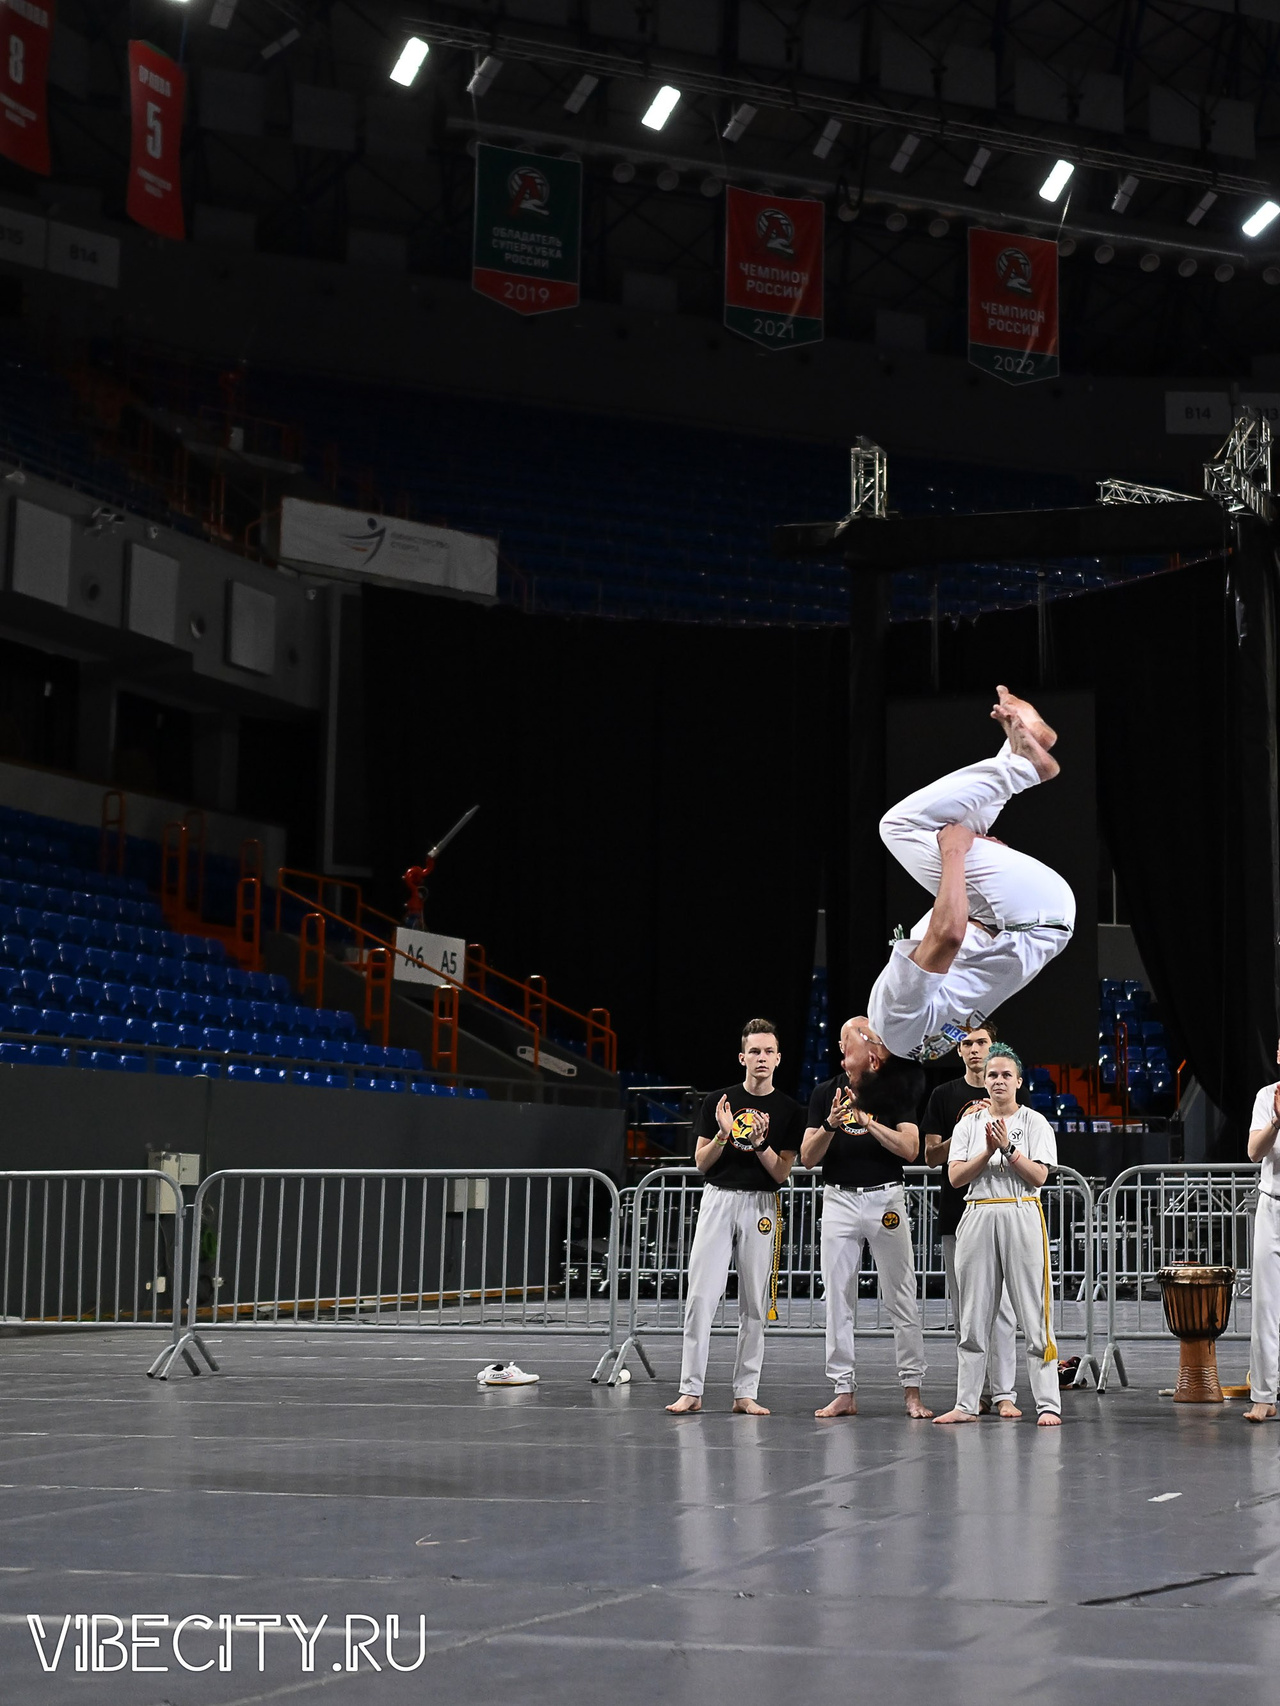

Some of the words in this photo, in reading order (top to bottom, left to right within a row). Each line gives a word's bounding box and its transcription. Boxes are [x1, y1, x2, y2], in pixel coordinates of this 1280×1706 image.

[9, 34, 24, 85] 8
[146, 101, 162, 159] 5
[492, 226, 563, 248] ОБЛАДАТЕЛЬ
[492, 238, 563, 259] СУПЕРКУБКА
[504, 252, 550, 269] РОССИИ
[739, 262, 809, 285] ЧЕМПИОН
[503, 282, 550, 303] 2019
[746, 279, 803, 299] РОССИИ
[981, 301, 1045, 323] ЧЕМПИОН
[753, 318, 795, 339] 2021
[988, 318, 1040, 337] РОССИИ
[993, 355, 1035, 376] 2022
